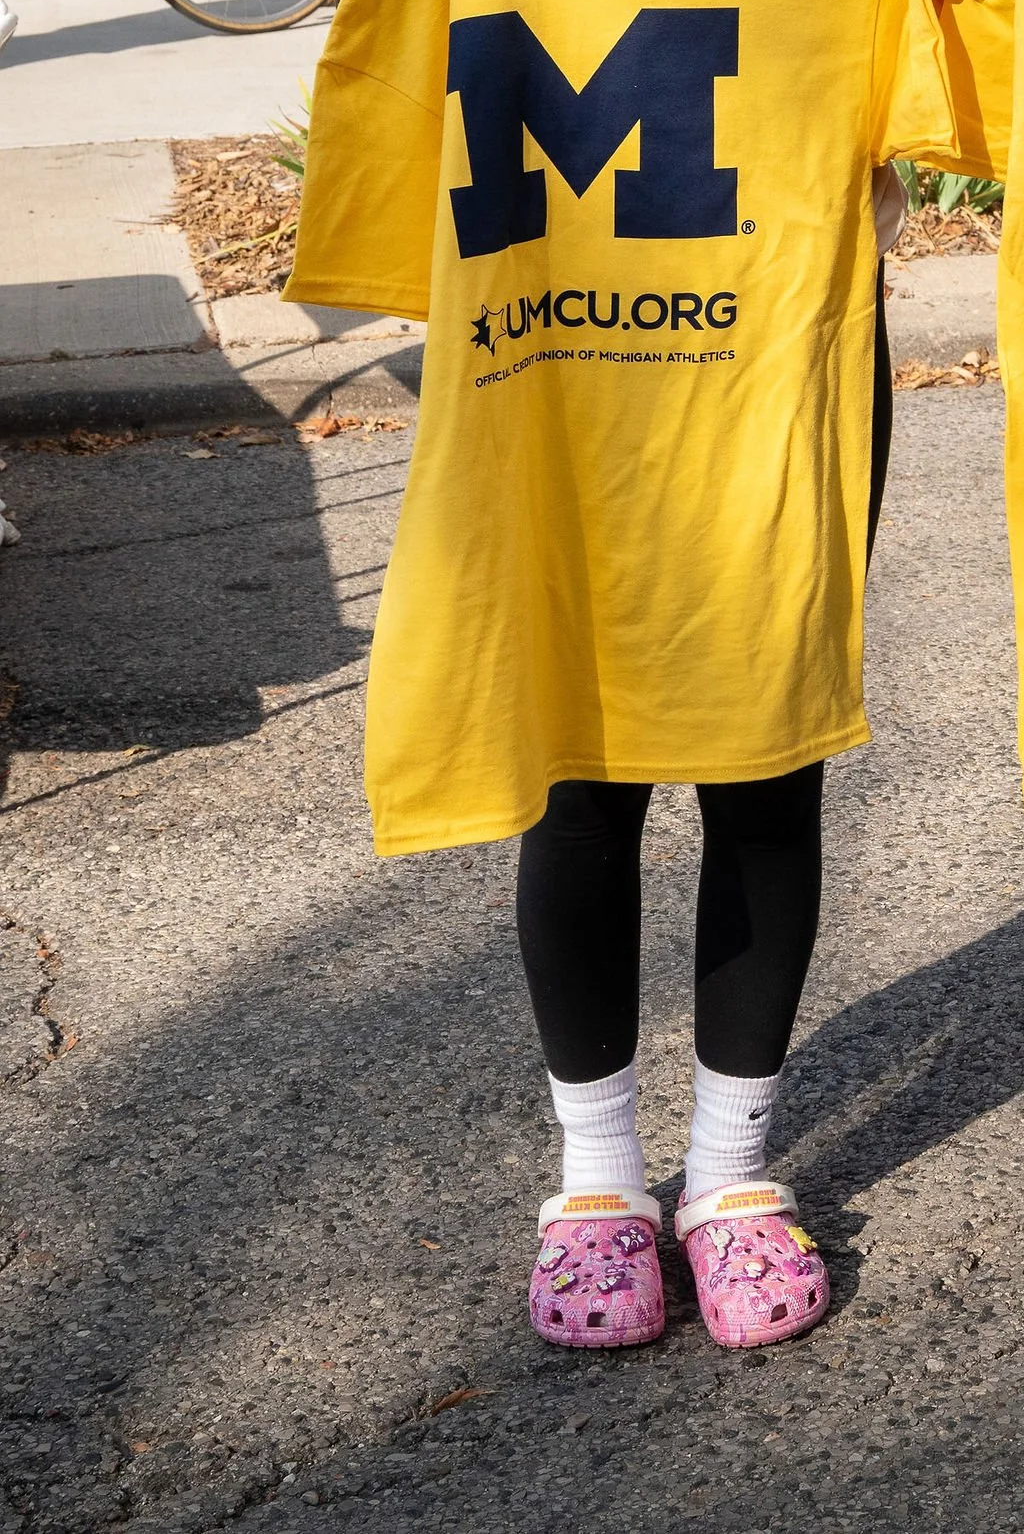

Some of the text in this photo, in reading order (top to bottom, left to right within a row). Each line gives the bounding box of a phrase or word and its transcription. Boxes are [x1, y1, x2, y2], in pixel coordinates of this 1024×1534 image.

[506, 289, 737, 339] UMCU.ORG
[475, 368, 511, 388] OFFICIL
[535, 349, 574, 362] UNION
[578, 350, 595, 361] OF
[599, 350, 662, 363] MICHIGAN
[667, 350, 736, 363] ATHLETICS
